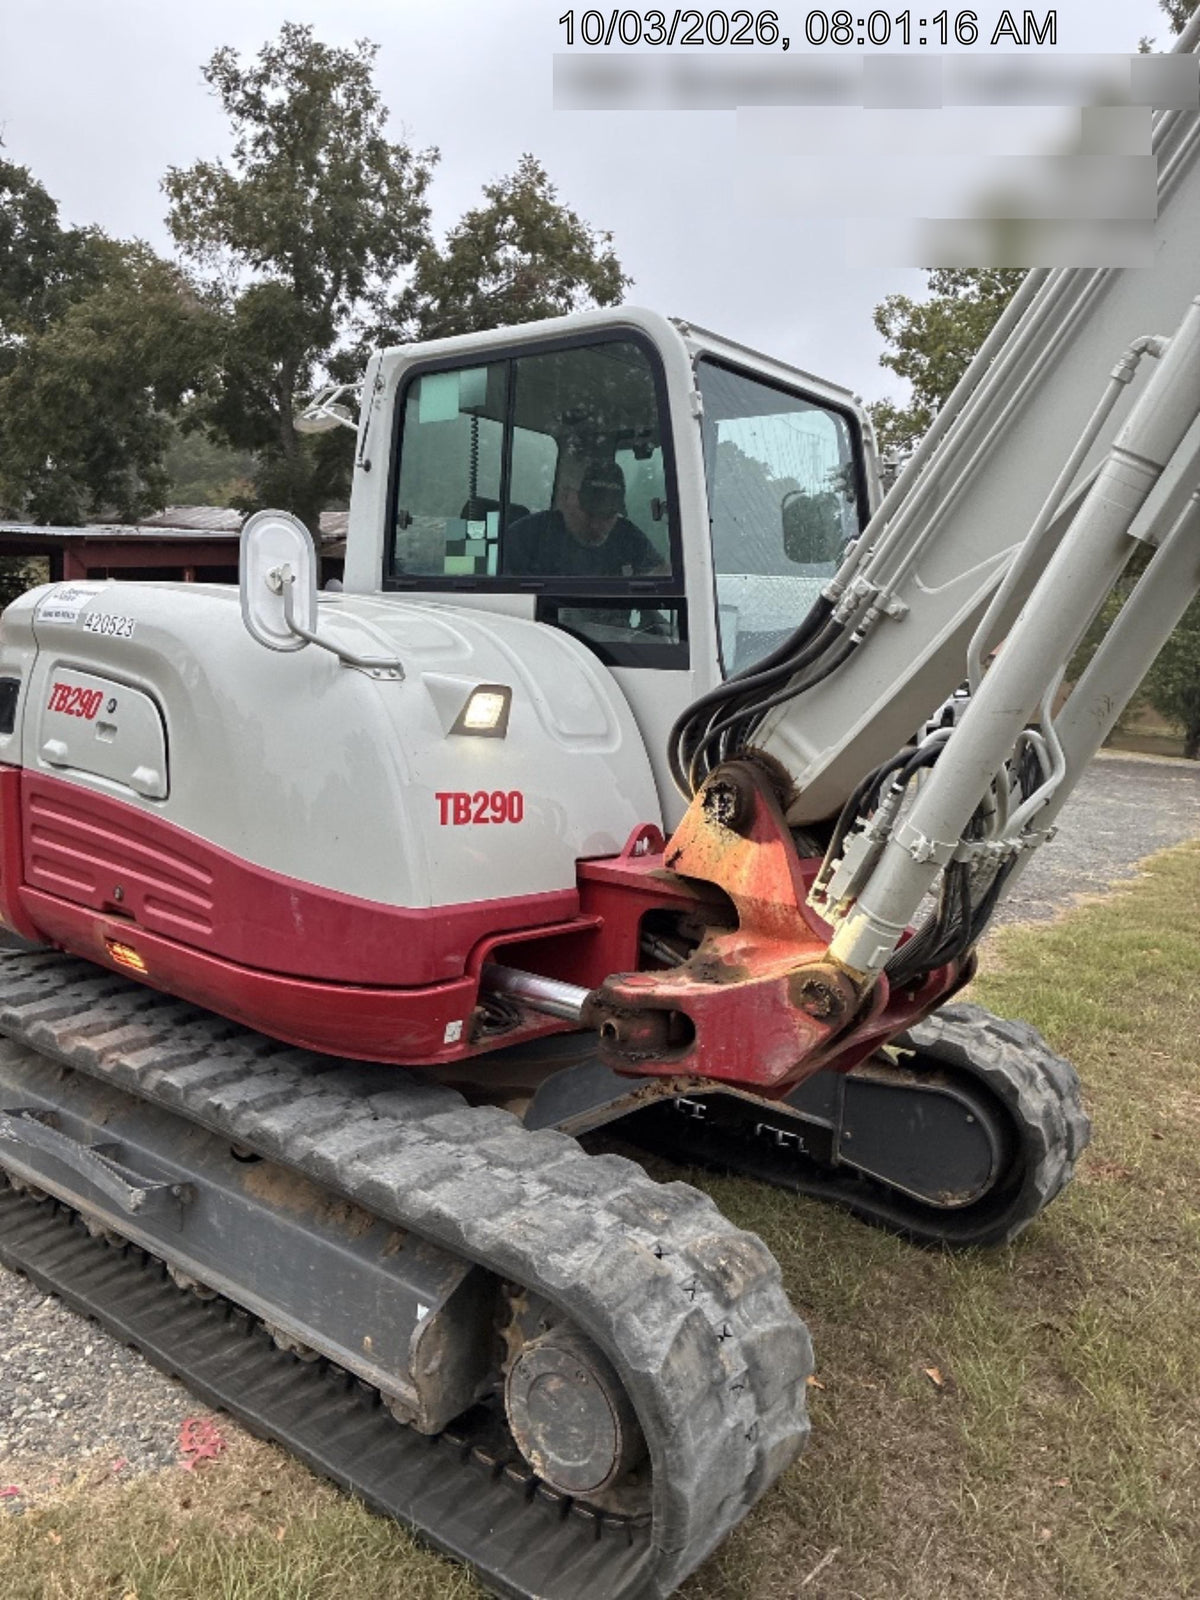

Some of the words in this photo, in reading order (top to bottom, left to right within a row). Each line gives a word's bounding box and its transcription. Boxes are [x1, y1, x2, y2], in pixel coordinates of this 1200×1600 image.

[85, 612, 134, 637] 420523
[47, 682, 103, 720] TB290
[435, 790, 523, 825] TB290
